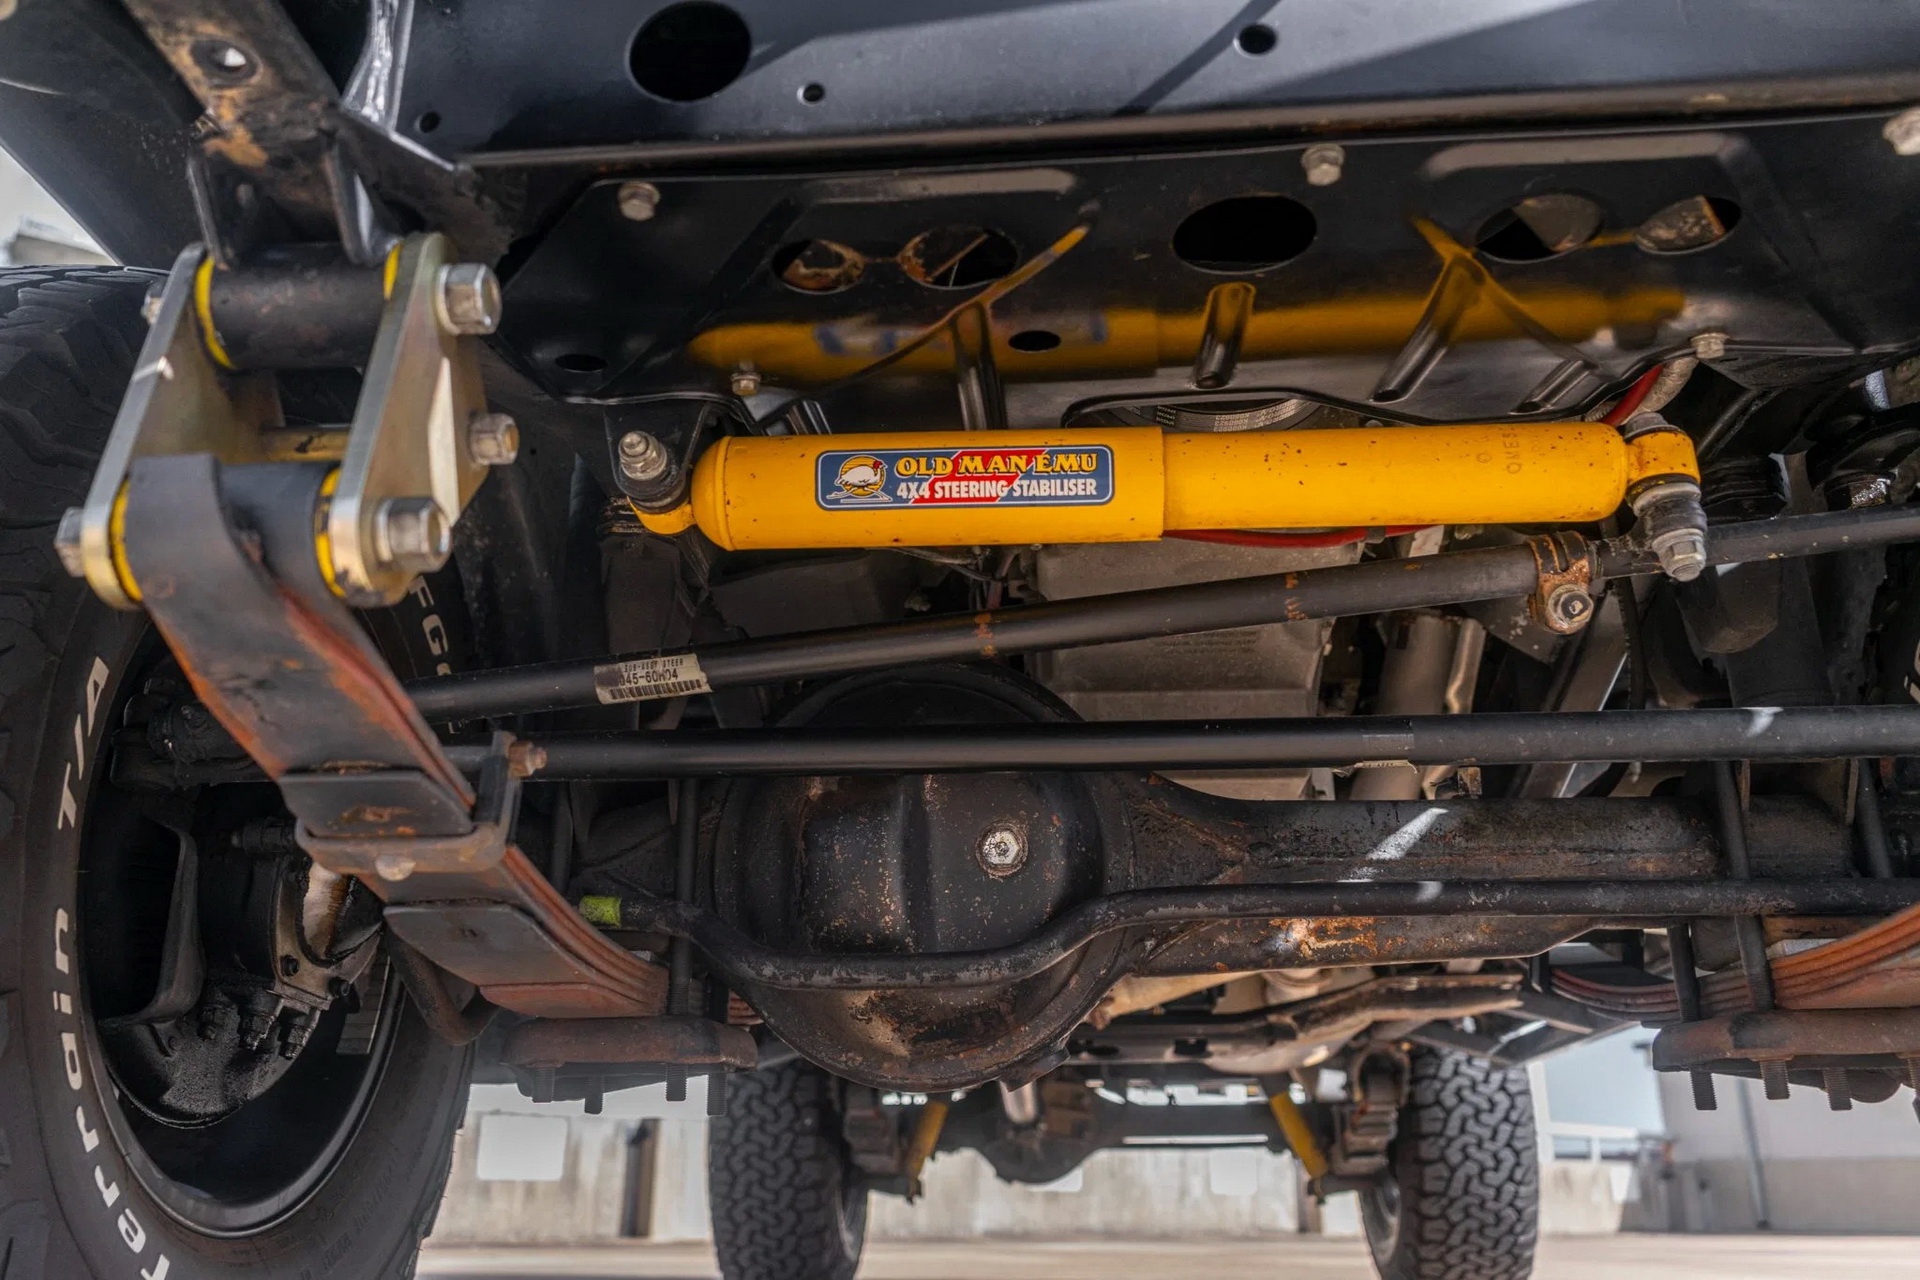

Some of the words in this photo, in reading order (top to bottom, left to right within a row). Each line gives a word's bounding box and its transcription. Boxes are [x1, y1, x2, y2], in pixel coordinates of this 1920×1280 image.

[894, 456, 952, 477] OLD
[956, 454, 1028, 476] MAN
[1033, 453, 1098, 475] EMU
[896, 481, 930, 499] 4X4
[934, 479, 1008, 498] STEERING
[1011, 478, 1097, 497] STABILISER
